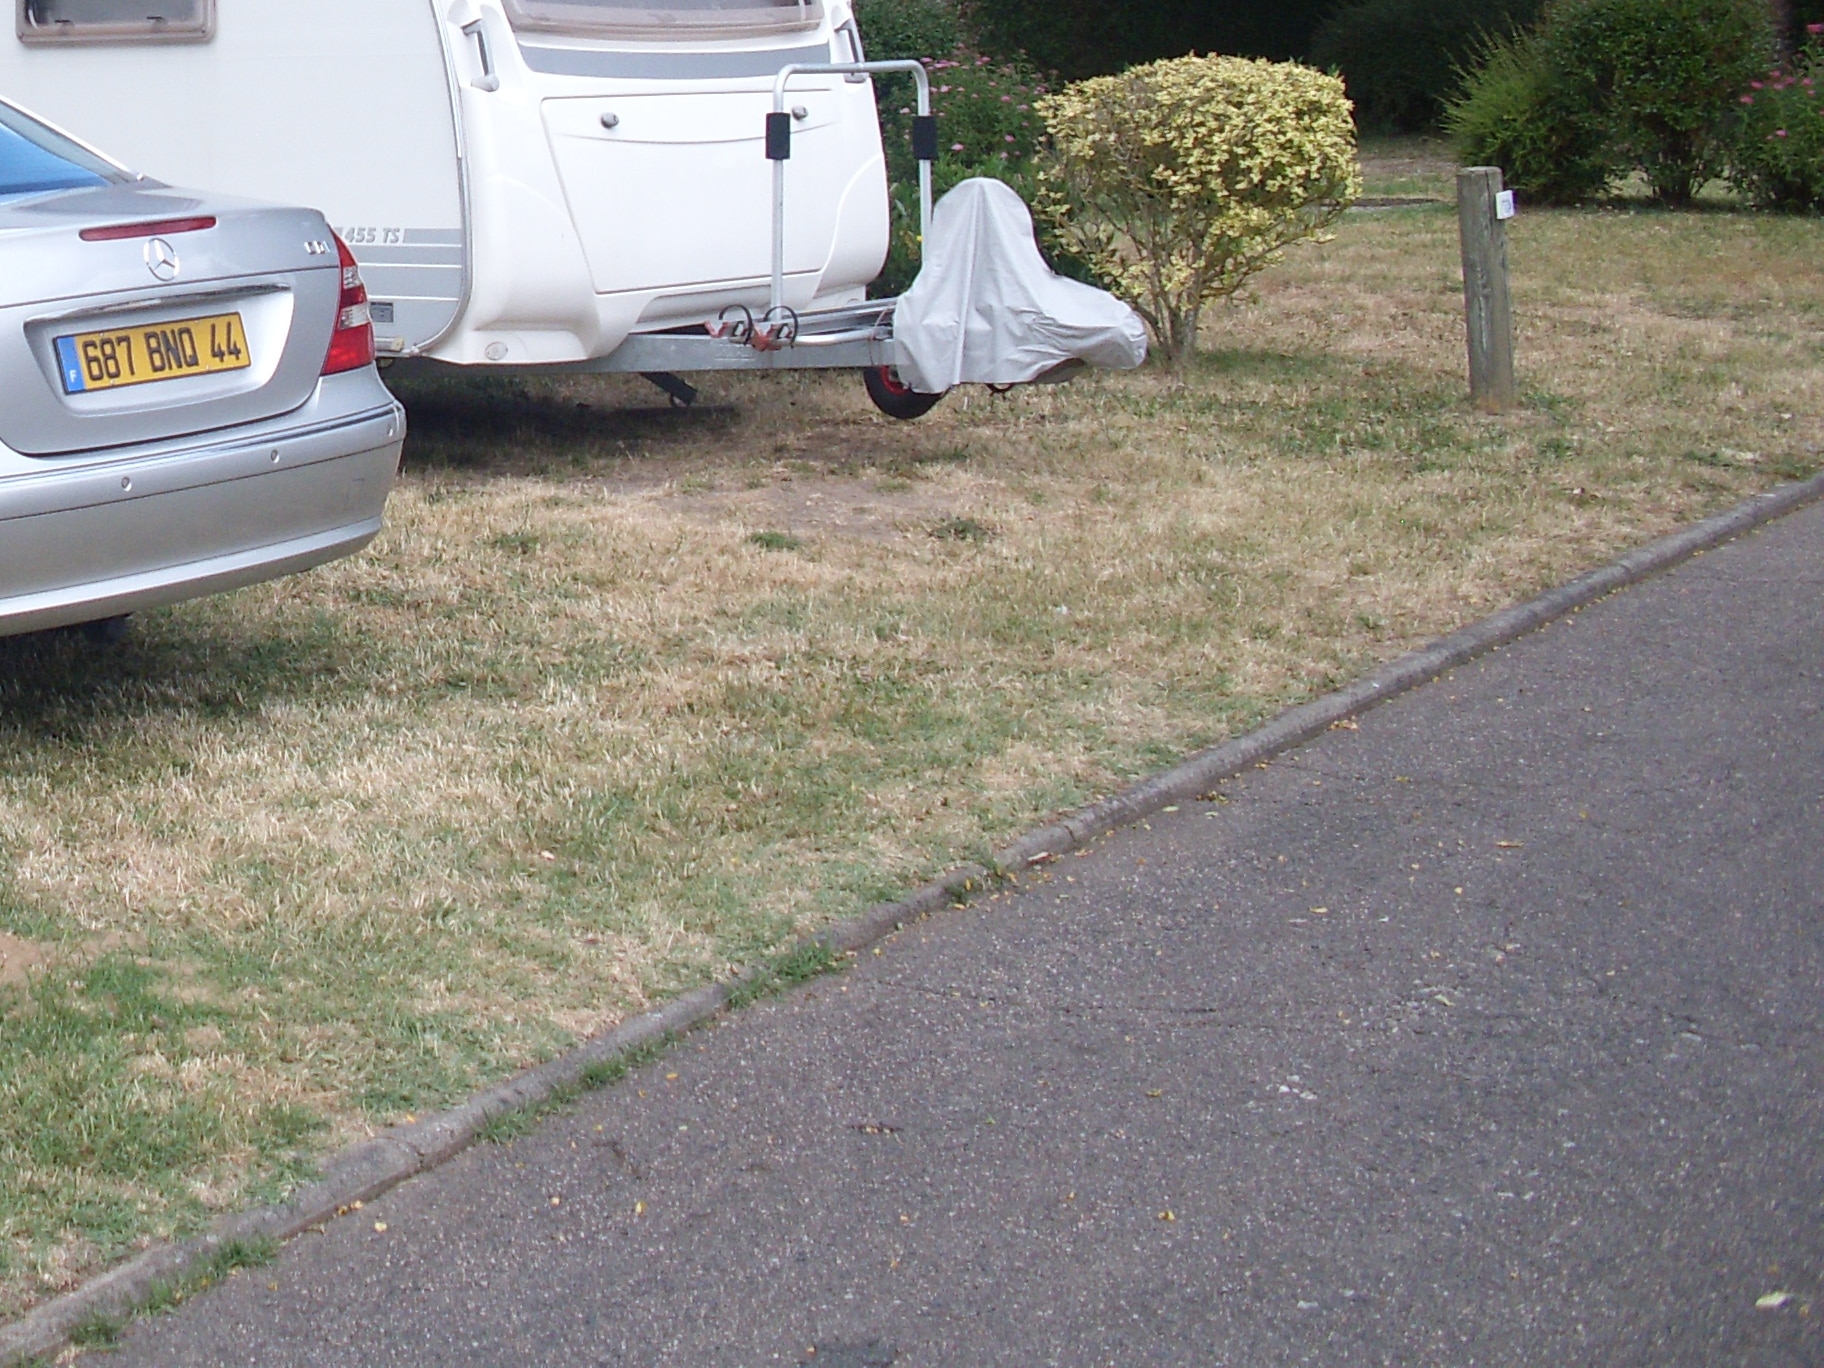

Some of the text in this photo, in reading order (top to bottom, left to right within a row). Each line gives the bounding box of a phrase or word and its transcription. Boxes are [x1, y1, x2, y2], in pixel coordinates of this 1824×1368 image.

[344, 226, 401, 243] 455 TS
[81, 320, 242, 382] 687 BNQ 44
[69, 369, 77, 383] F
